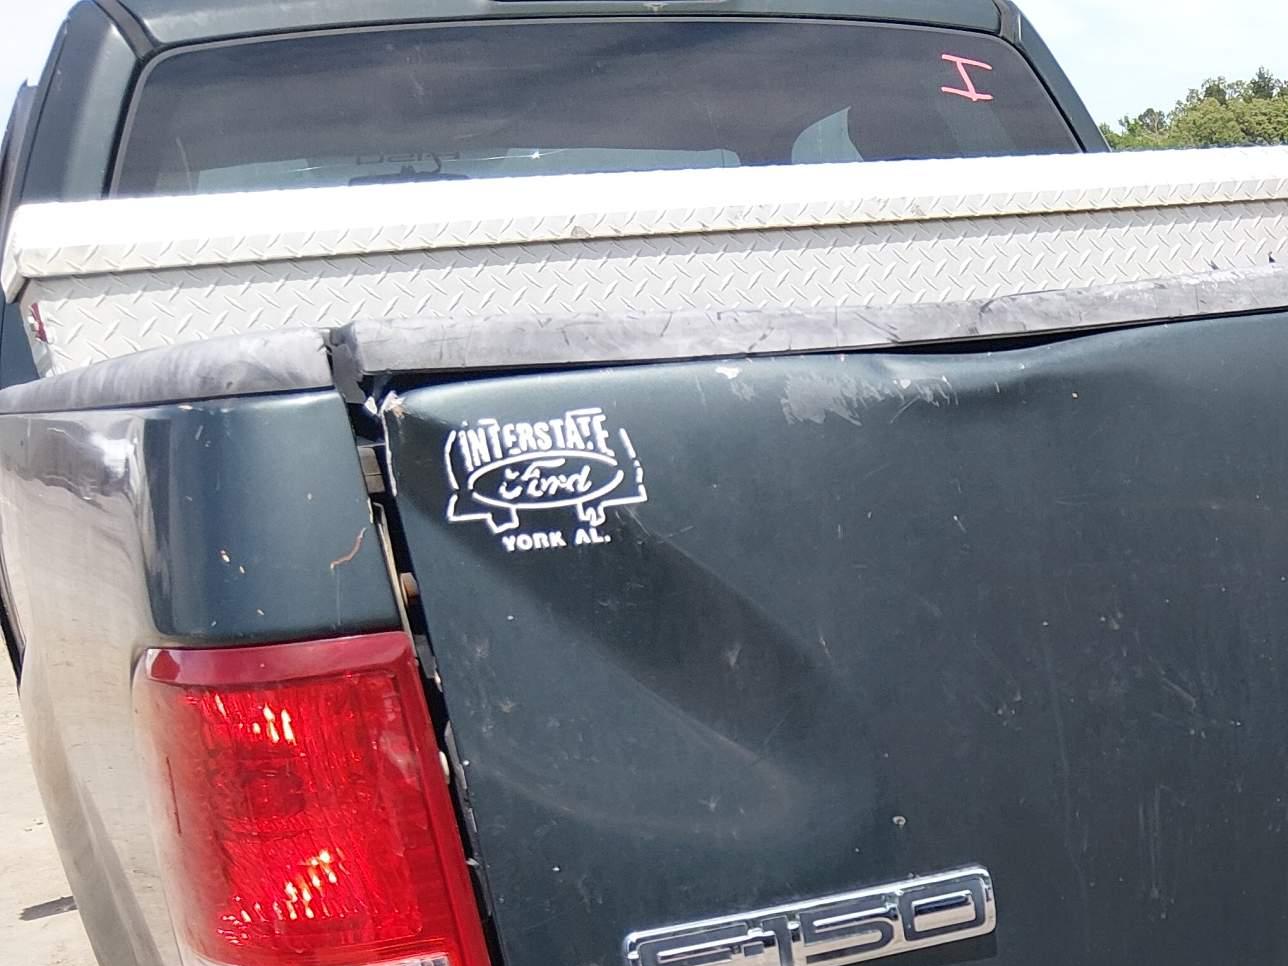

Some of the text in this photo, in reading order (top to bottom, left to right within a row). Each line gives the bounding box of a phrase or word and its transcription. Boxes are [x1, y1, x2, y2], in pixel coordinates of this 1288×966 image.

[458, 407, 615, 472] INTERSTATE
[499, 458, 592, 500] Ford
[502, 528, 612, 551] YORK AL.
